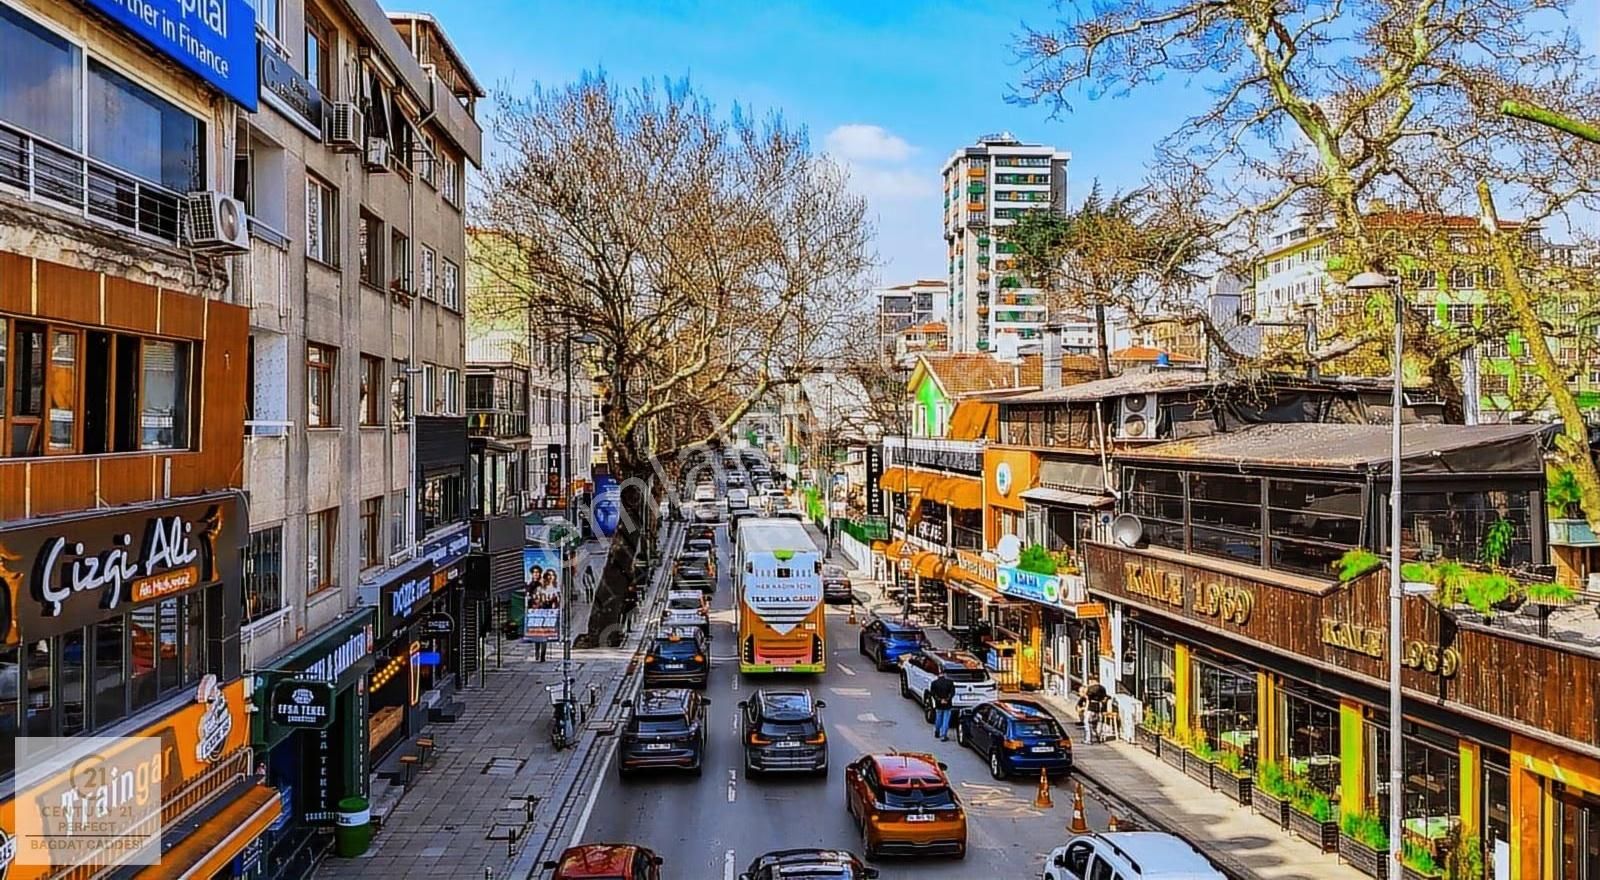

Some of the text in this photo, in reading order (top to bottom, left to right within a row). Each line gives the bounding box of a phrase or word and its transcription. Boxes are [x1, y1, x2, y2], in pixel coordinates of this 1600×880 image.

[162, 9, 176, 42] in
[179, 23, 229, 79] Finance
[43, 516, 197, 607] Çizgi Ali
[1124, 561, 1255, 625] KALE 1969
[1320, 618, 1382, 658] KALE
[301, 705, 327, 717] TEKEL
